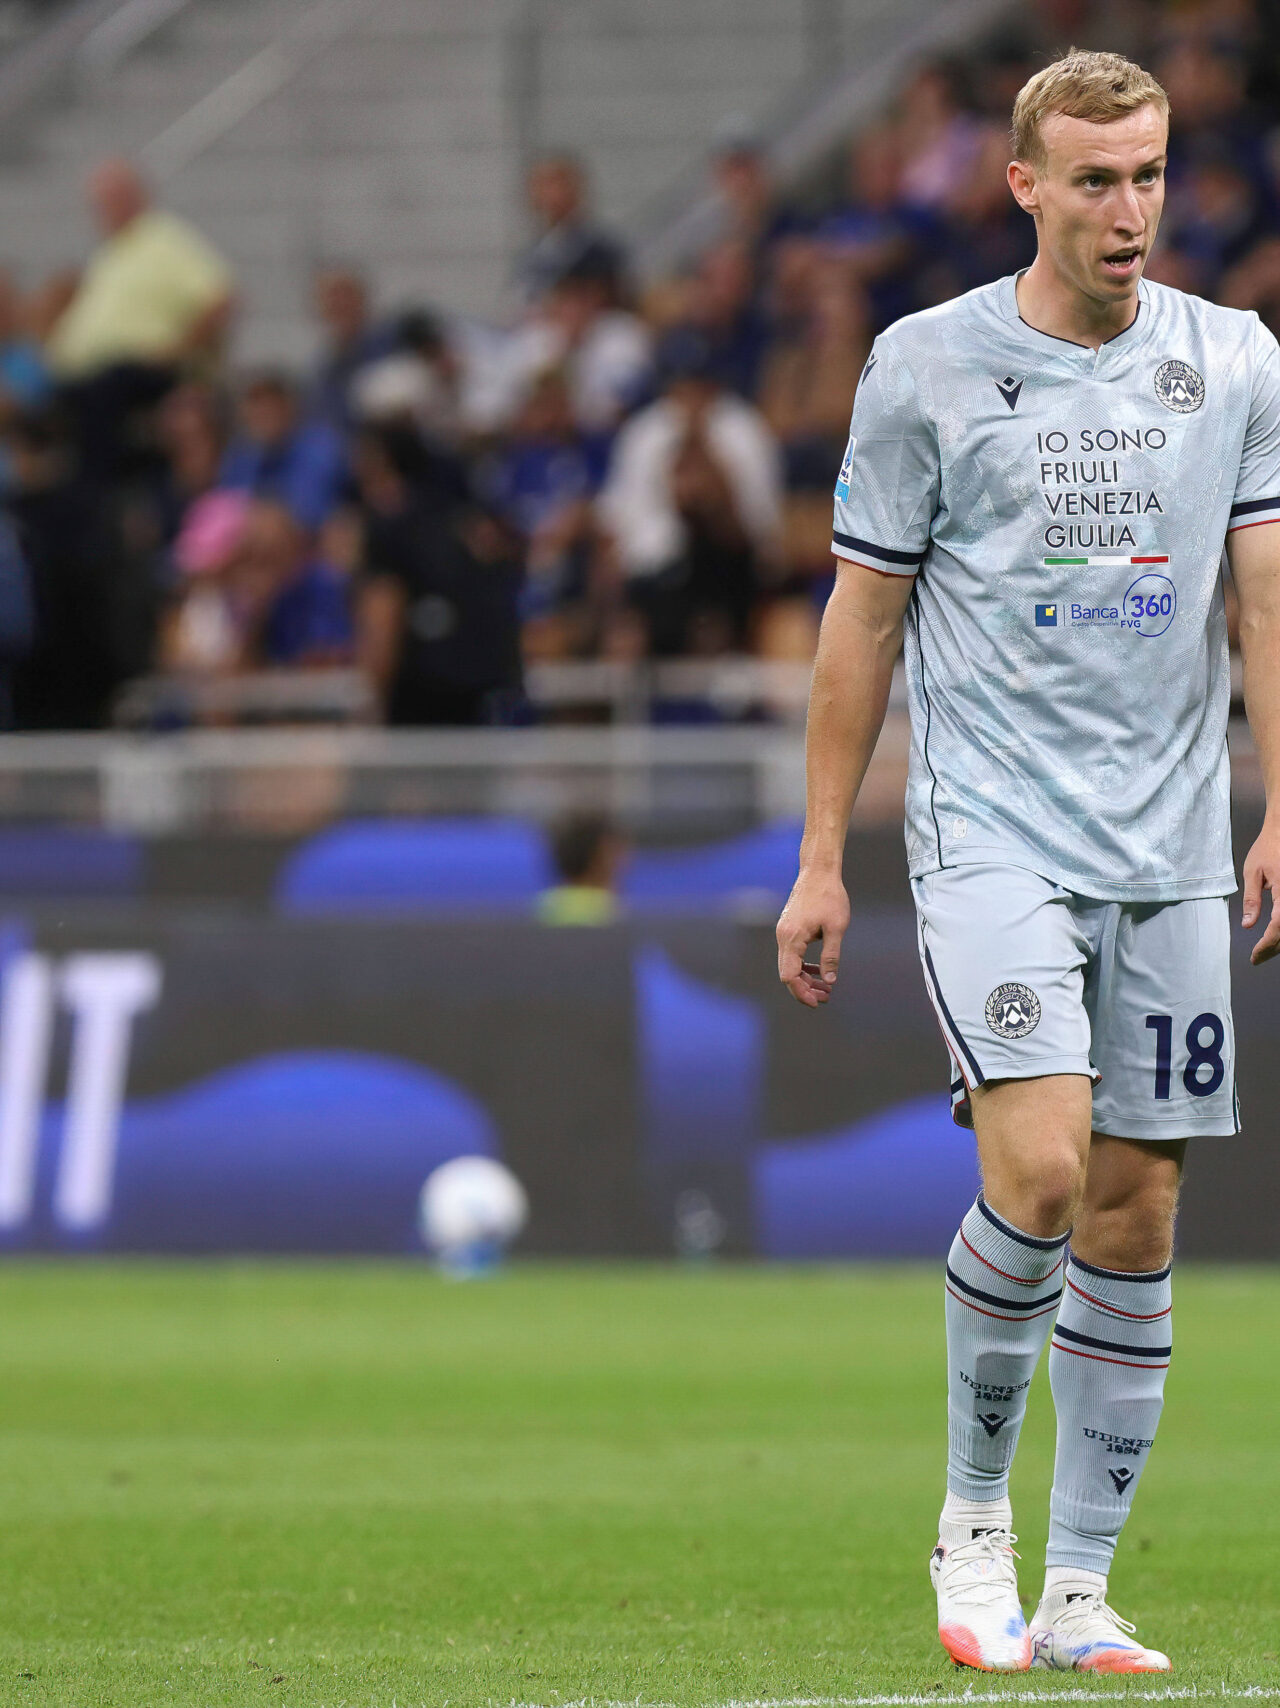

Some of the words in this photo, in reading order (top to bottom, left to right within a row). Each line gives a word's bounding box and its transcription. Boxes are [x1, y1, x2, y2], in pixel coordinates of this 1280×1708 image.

[1037, 431, 1069, 453] IO
[1080, 428, 1166, 452] SONO
[1040, 461, 1118, 484] FRIULI
[1044, 490, 1163, 516] VENEZIA
[1044, 523, 1137, 548] GIULIA
[1071, 603, 1119, 620] Banca
[1130, 593, 1172, 618] 360
[1120, 620, 1141, 629] FVG
[1000, 984, 1018, 994] 1896
[1146, 1012, 1224, 1099] 18
[959, 1370, 1031, 1394] UDINESE
